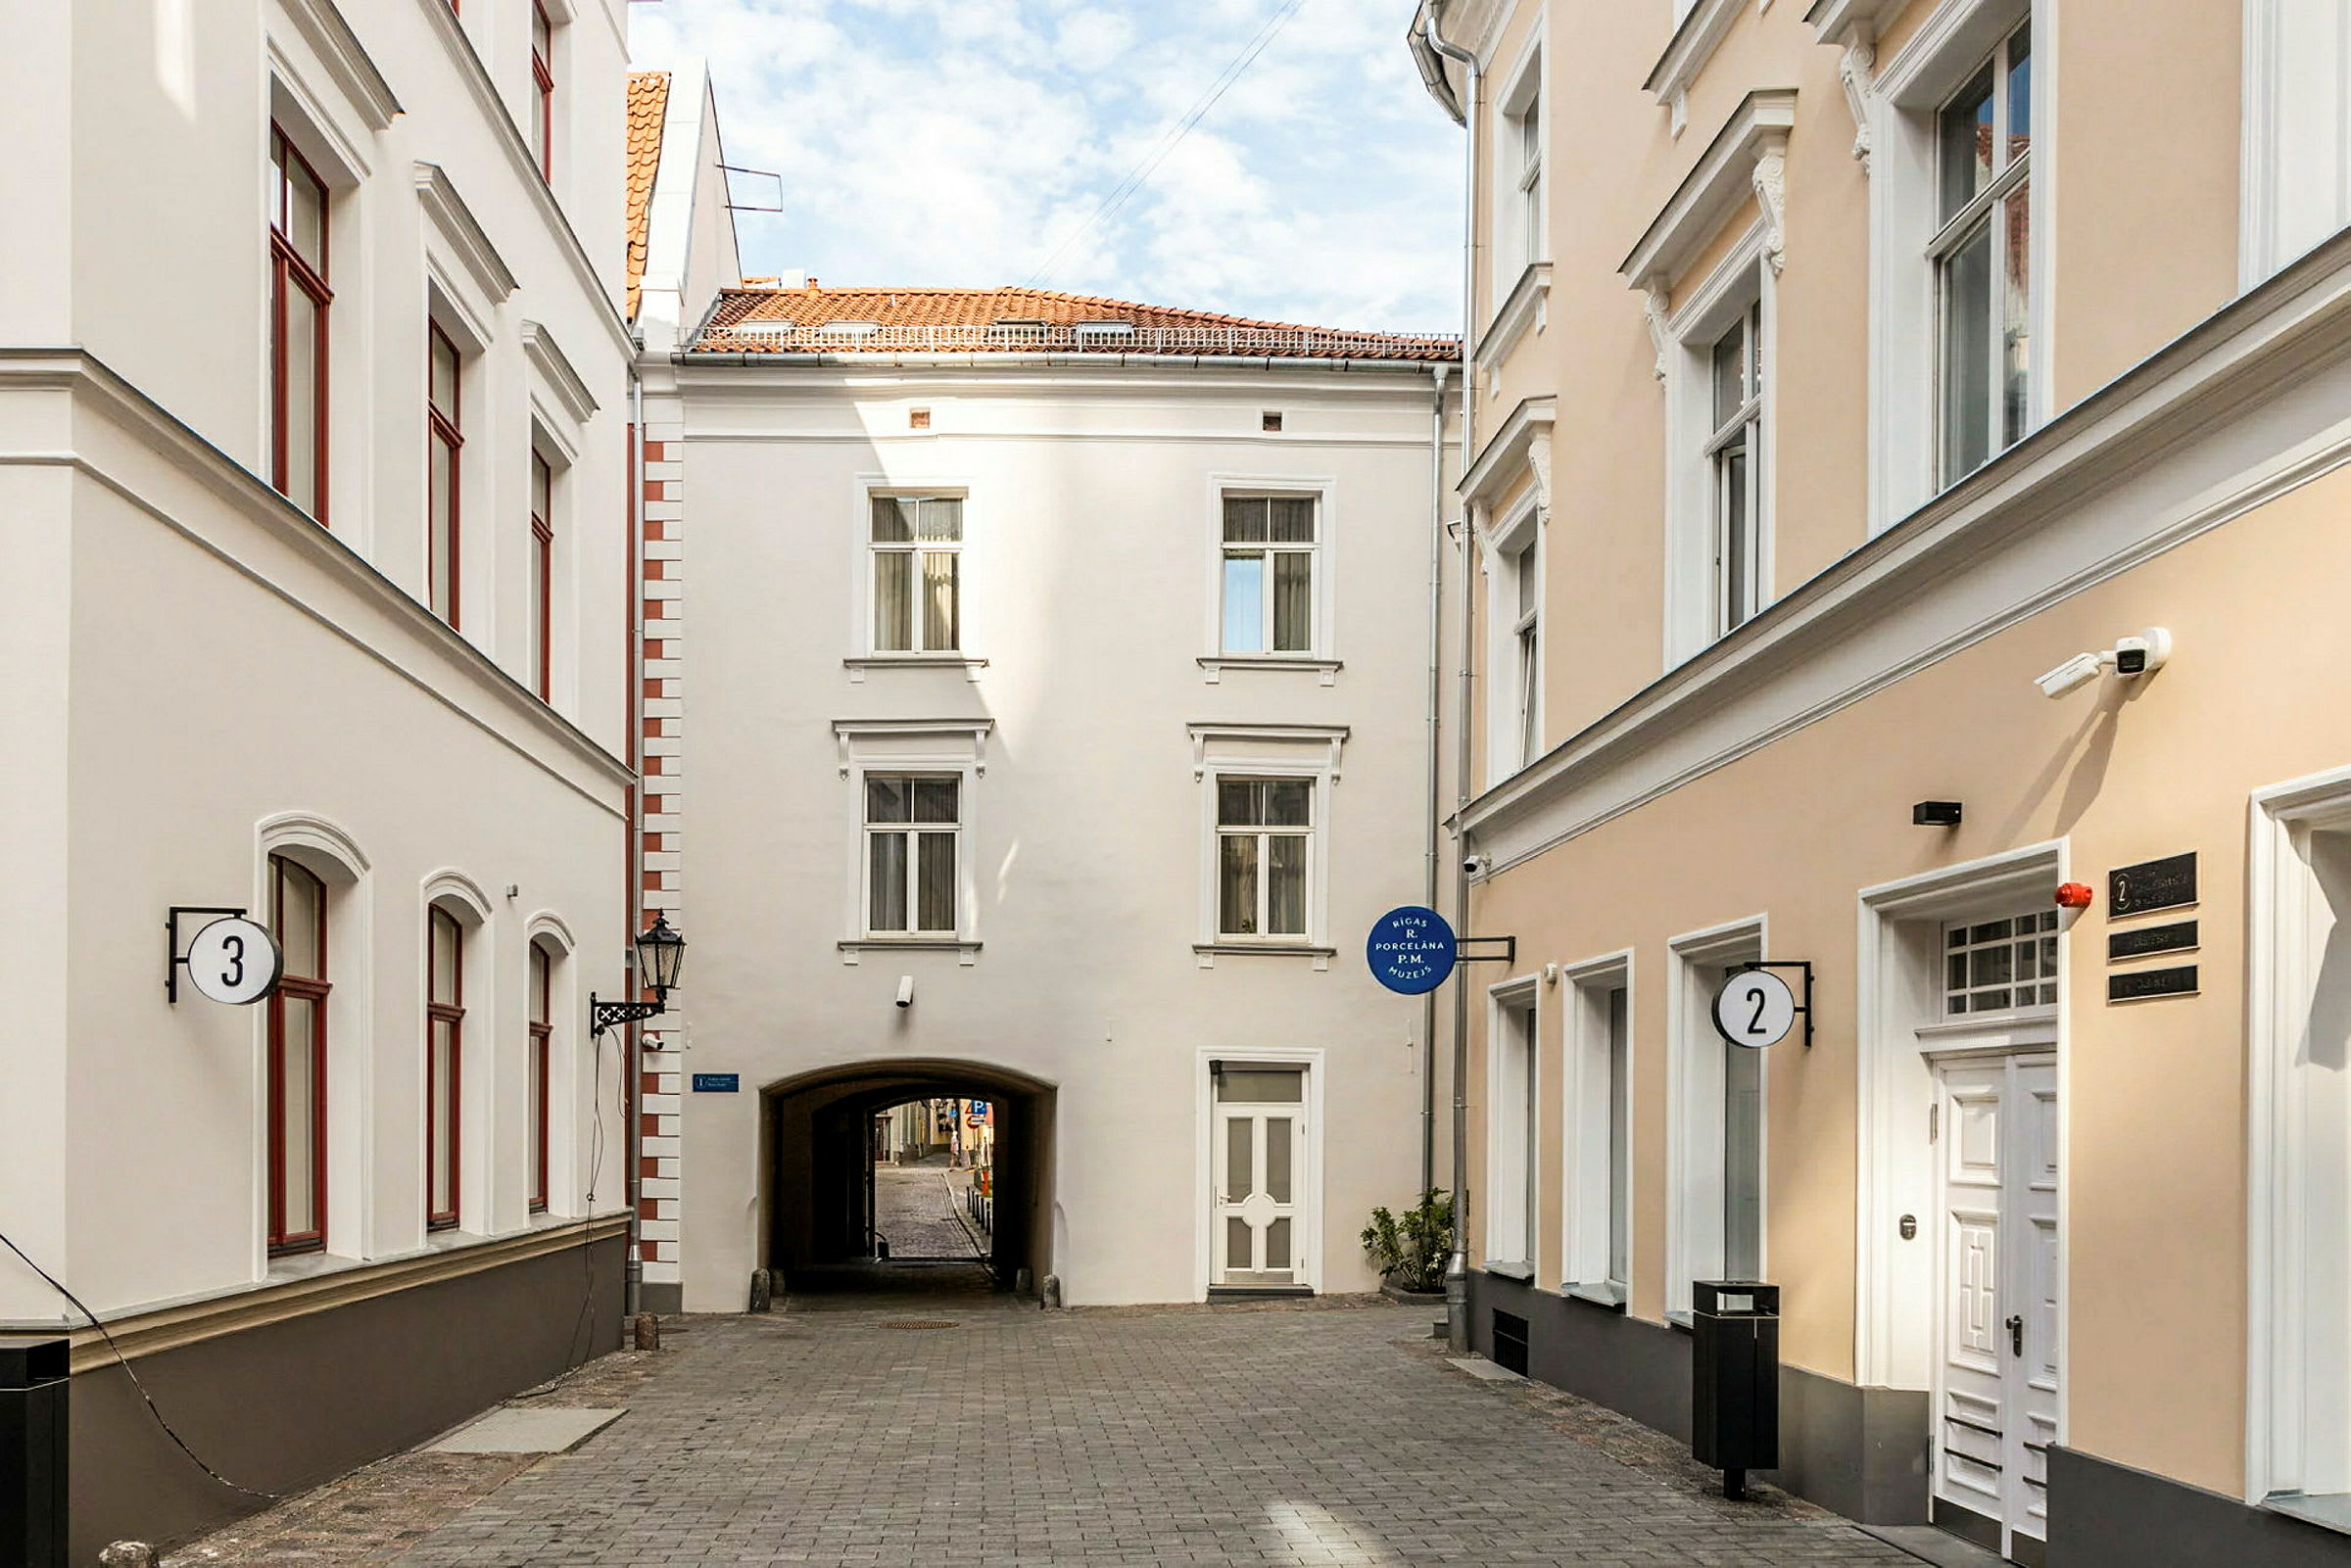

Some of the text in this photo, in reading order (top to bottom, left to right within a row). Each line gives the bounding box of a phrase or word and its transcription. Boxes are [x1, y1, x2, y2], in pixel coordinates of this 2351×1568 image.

[2118, 880, 2126, 902] 2
[1406, 928, 1418, 938] R.
[1375, 941, 1444, 951] PORCELĀNA
[221, 935, 244, 987] 3
[1388, 966, 1432, 979] MUZEJS
[1747, 987, 1766, 1034] 2
[975, 1101, 984, 1113] P
